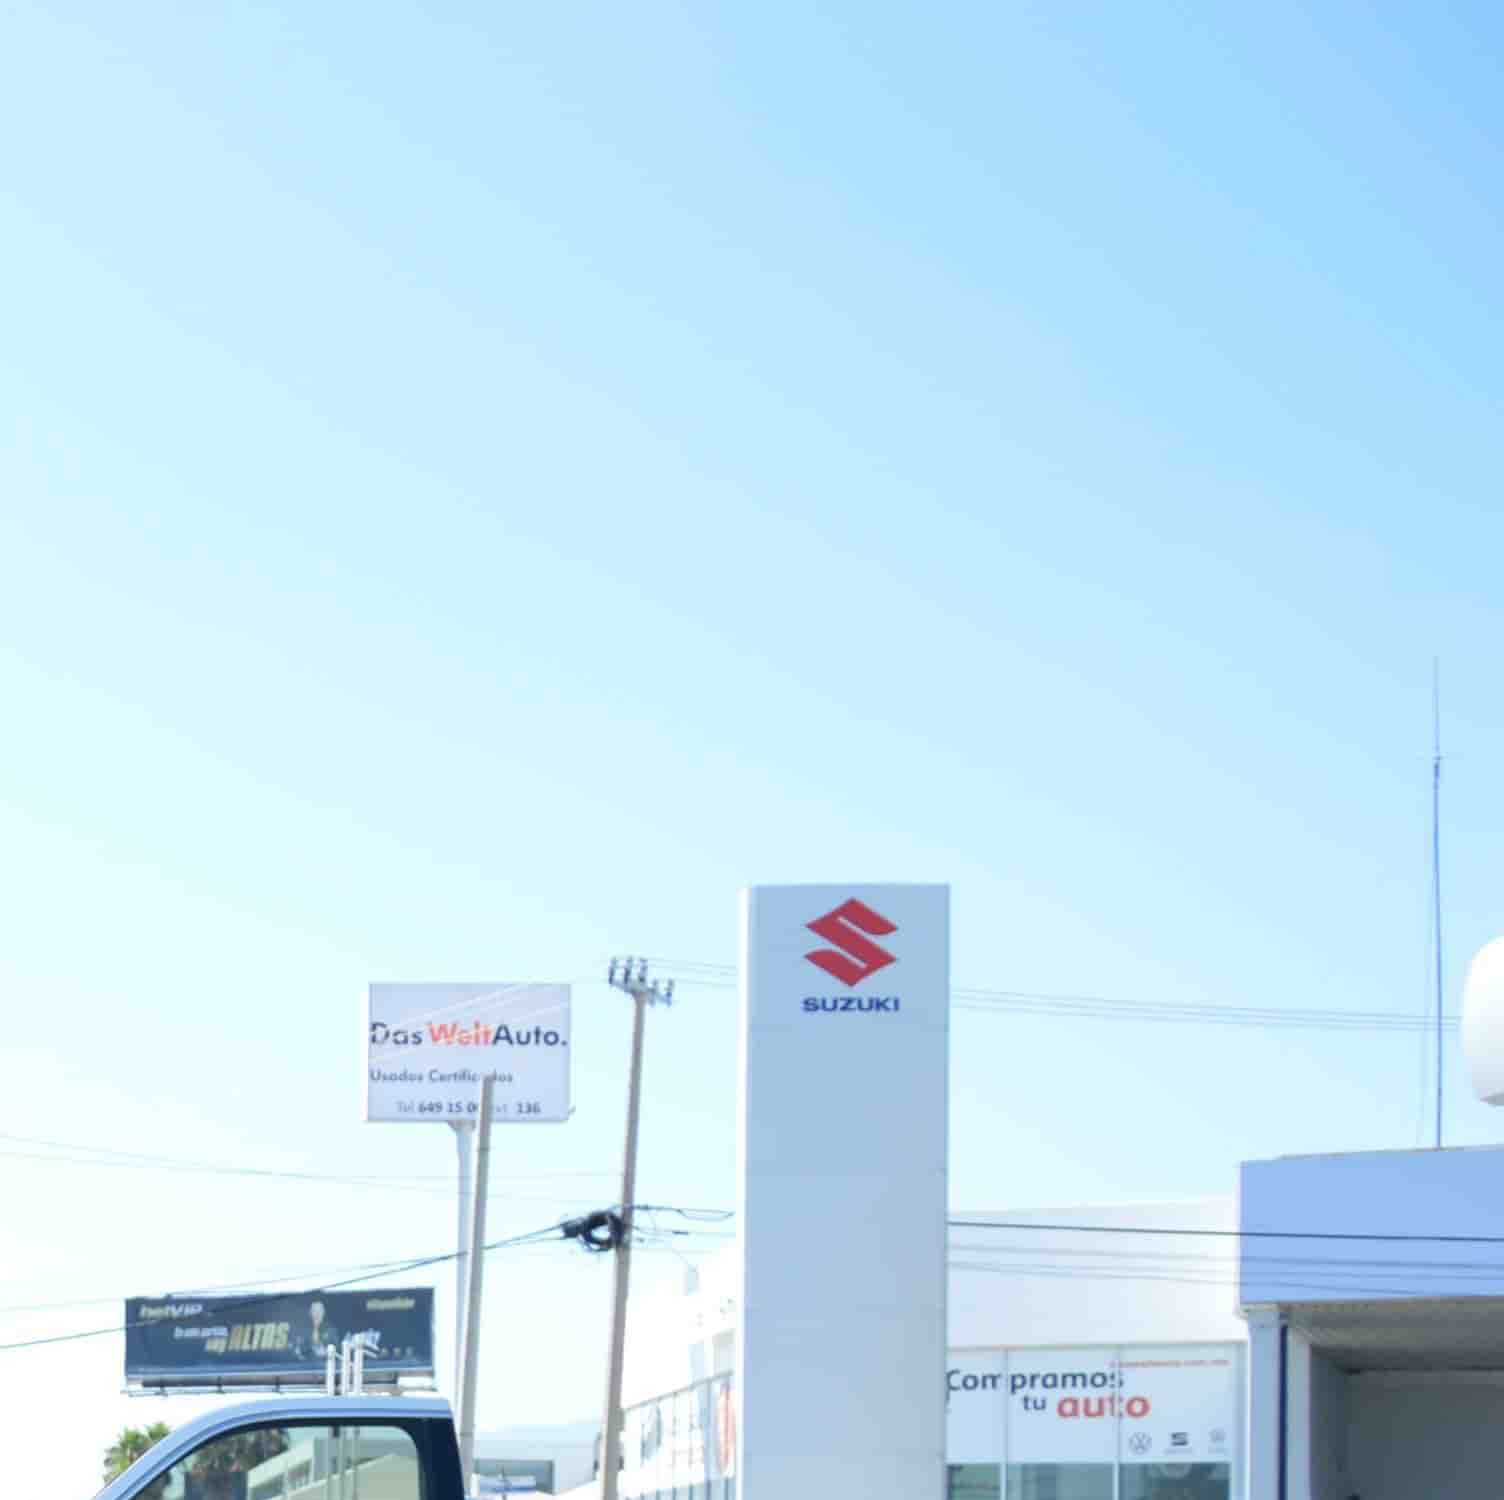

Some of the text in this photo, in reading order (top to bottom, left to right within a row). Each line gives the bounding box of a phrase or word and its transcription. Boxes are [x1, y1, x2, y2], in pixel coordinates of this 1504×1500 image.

[802, 997, 900, 1012] SUZUKI
[370, 1022, 423, 1046] Das
[369, 1069, 424, 1083] Usados
[946, 1369, 1124, 1394] Compramos
[1022, 1395, 1151, 1419] tu auto
